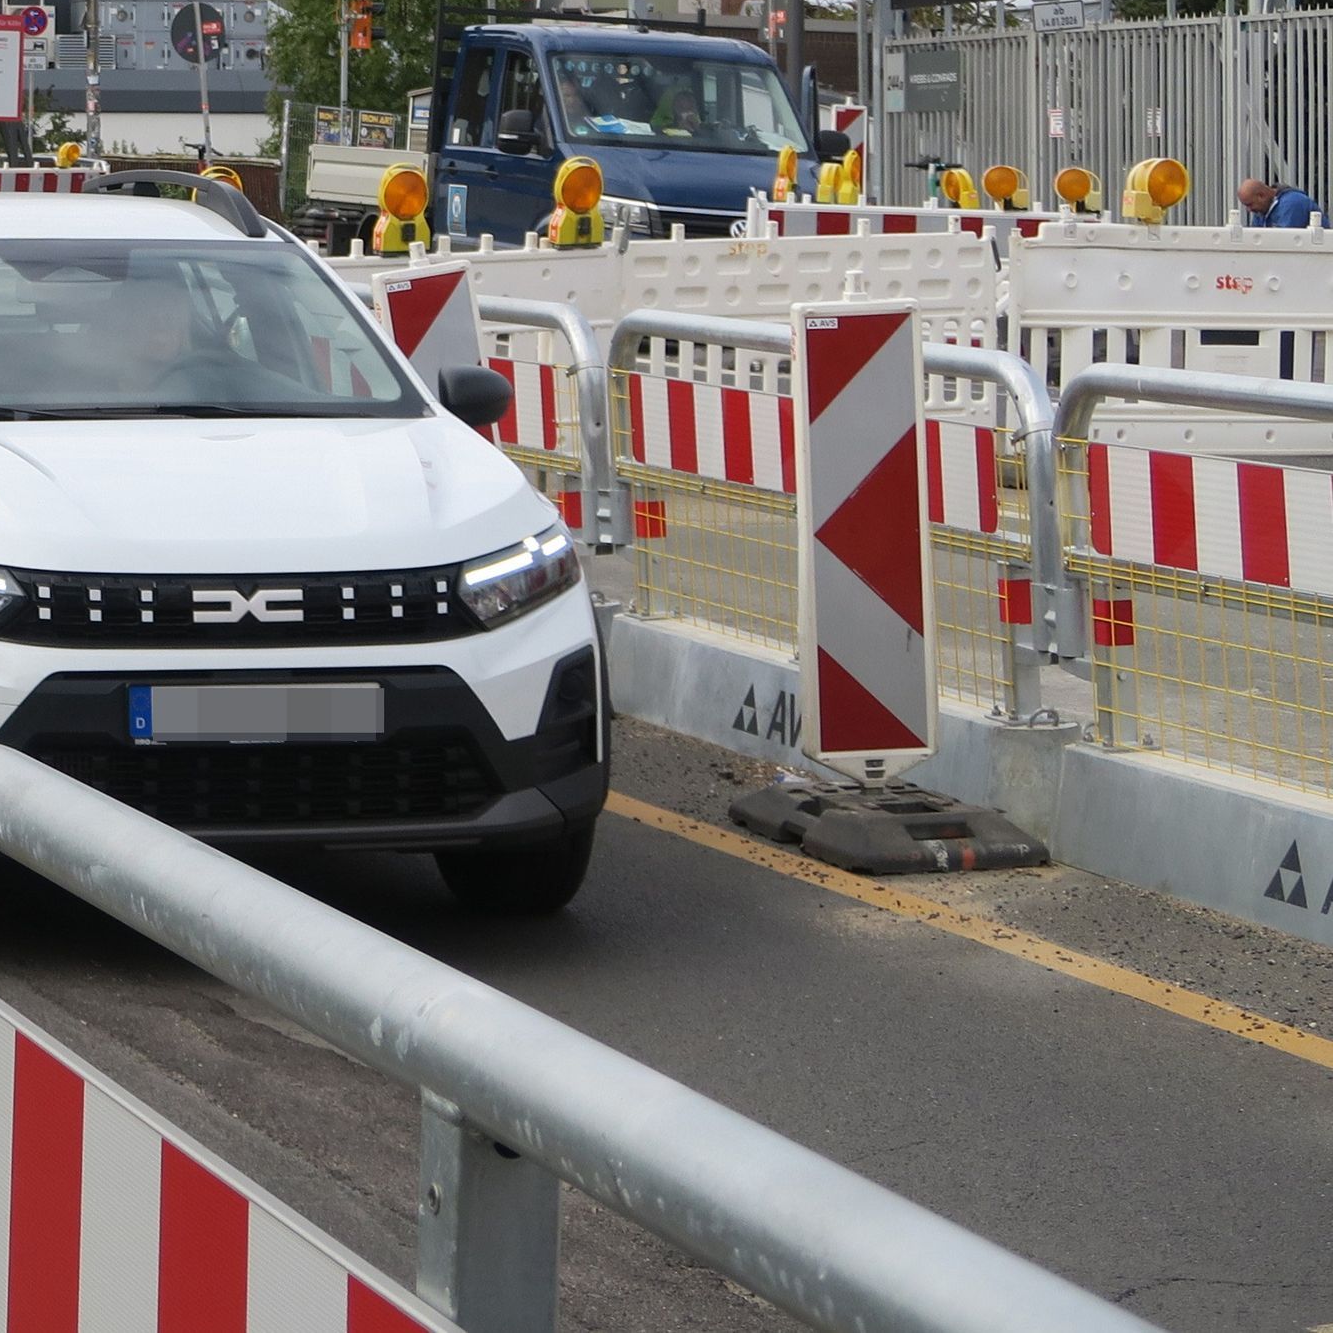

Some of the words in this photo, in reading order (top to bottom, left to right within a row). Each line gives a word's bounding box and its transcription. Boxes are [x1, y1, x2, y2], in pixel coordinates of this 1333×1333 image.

[1053, 6, 1065, 15] ab
[819, 319, 836, 327] AVS
[136, 717, 146, 729] D
[766, 690, 802, 748] AV
